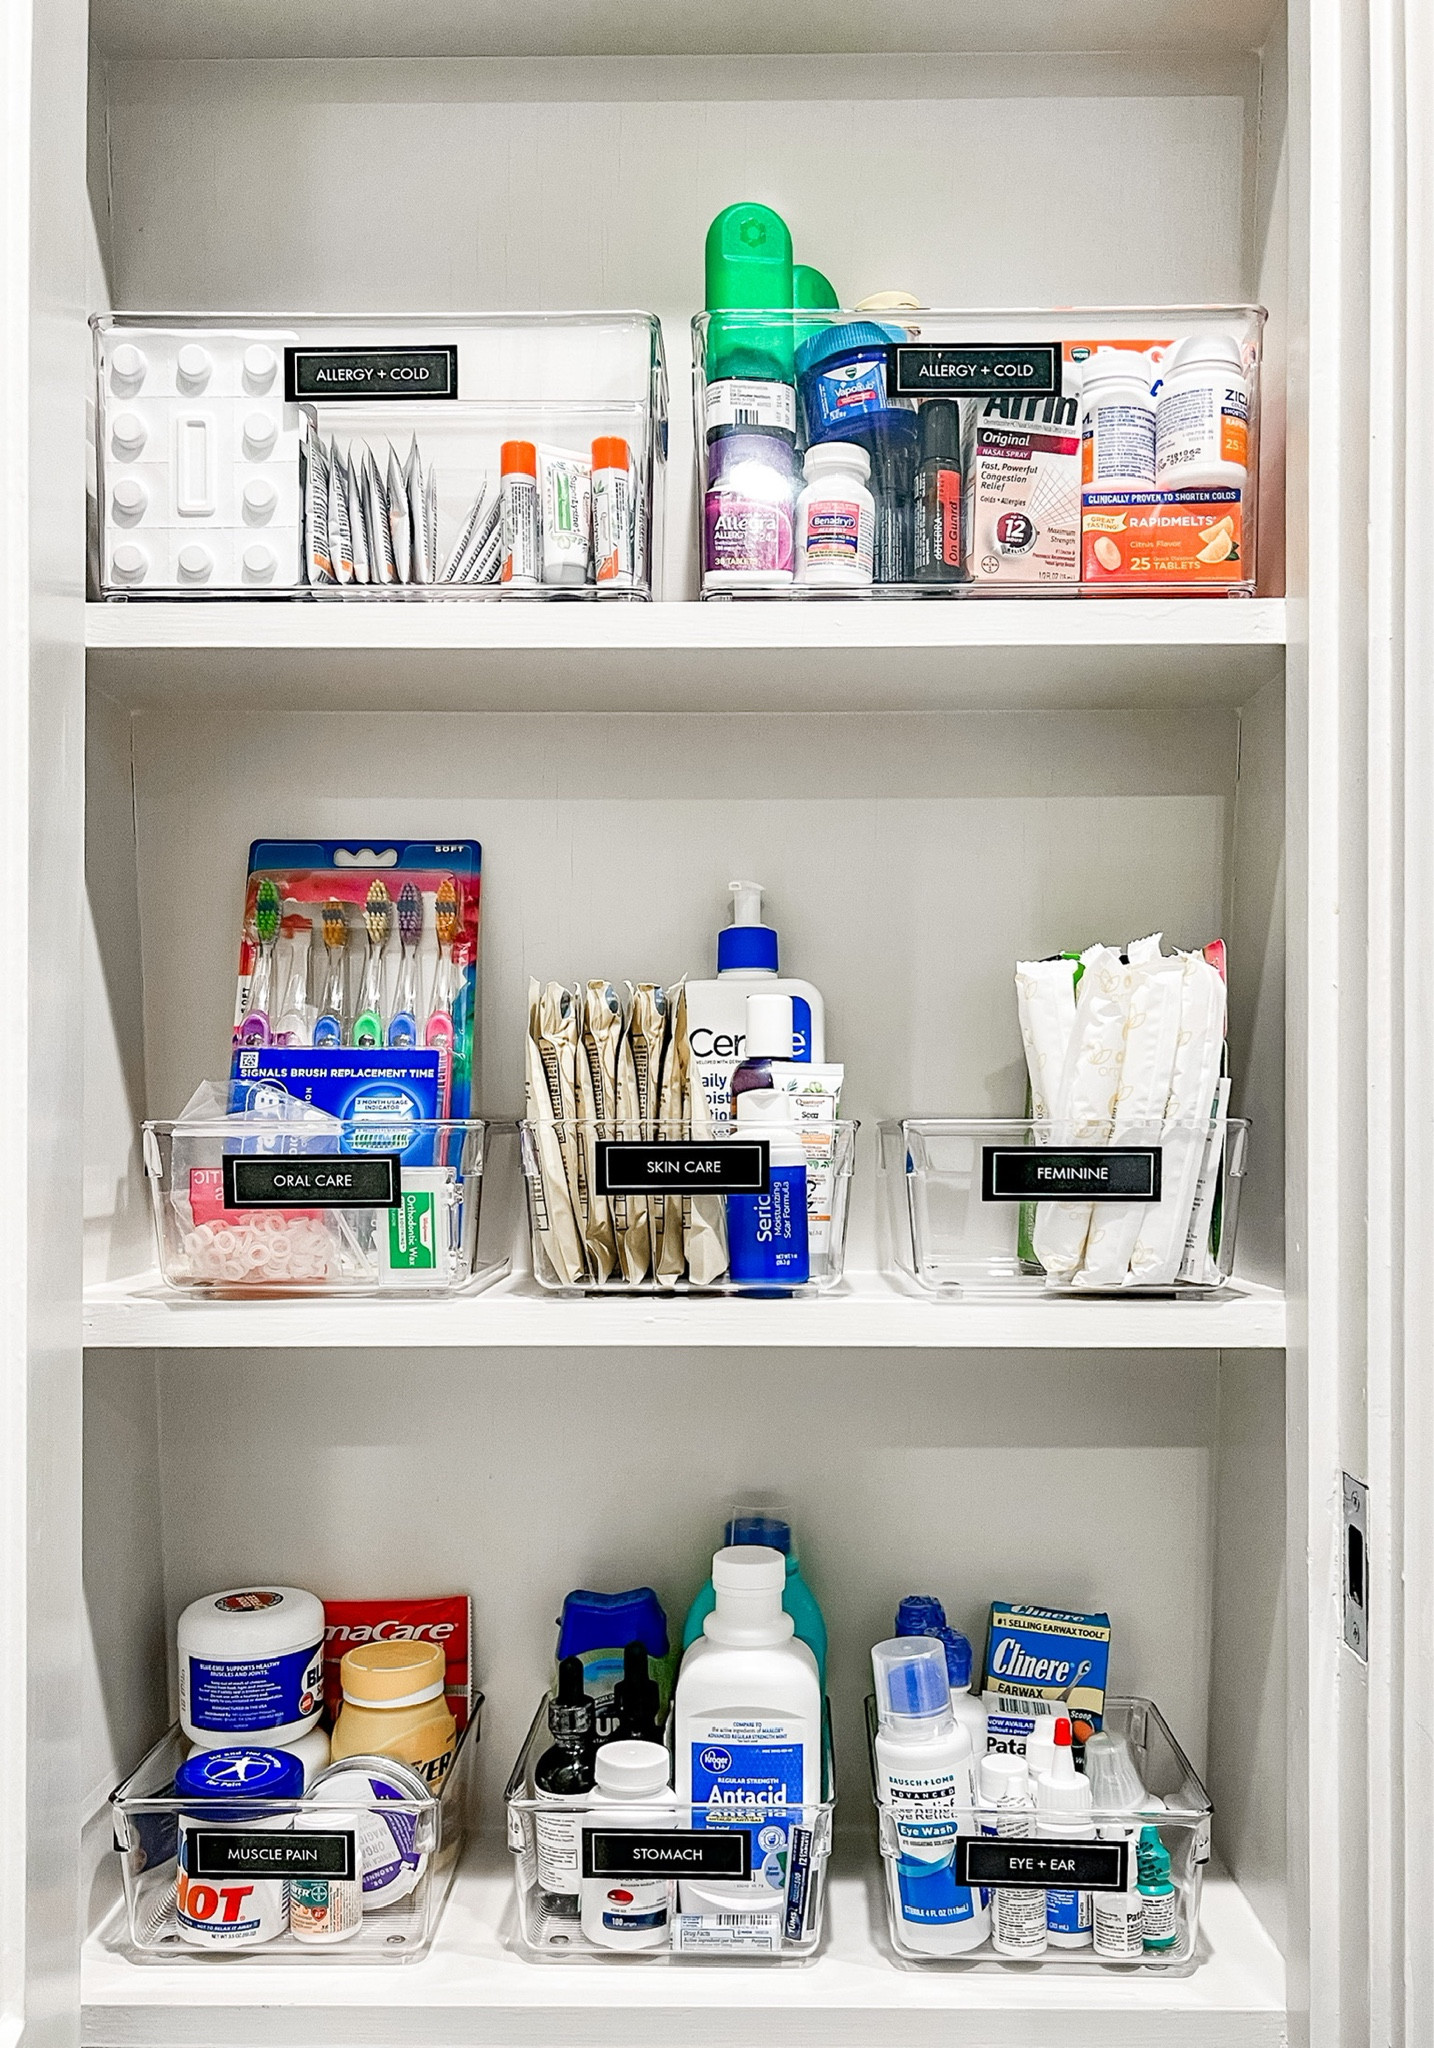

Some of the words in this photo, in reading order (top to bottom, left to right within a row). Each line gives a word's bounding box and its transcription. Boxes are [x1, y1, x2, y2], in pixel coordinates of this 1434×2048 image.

[316, 368, 374, 382] ALLERGY
[376, 371, 387, 379] +
[390, 367, 430, 380] COLD
[918, 364, 977, 378] ALLERGY
[980, 366, 990, 375] +
[994, 364, 1034, 377] COLD
[982, 431, 1030, 446] Original
[982, 448, 1005, 456] NASAL
[1006, 450, 1028, 458] SPRAY
[1002, 462, 1038, 476] Powerful
[980, 471, 1027, 483] Congestion
[980, 482, 1005, 492] Relief
[1088, 494, 1129, 504] CLINICALLY
[1131, 492, 1163, 504] PROVEN
[1163, 493, 1174, 502] TO
[1175, 492, 1210, 501] SHORTEN
[1212, 491, 1236, 500] COLDS
[714, 514, 776, 532] Allegra
[949, 500, 958, 541] Guard
[1129, 516, 1214, 528] RAPIDMELTS
[1005, 519, 1026, 538] 12
[1156, 540, 1182, 548] Flavor
[948, 544, 958, 562] On
[1130, 557, 1151, 571] 25
[1154, 561, 1201, 570] TABLETS
[689, 1028, 806, 1057] Cere
[240, 1068, 288, 1078] SIGNALS
[290, 1068, 328, 1078] BRUSH
[330, 1068, 407, 1078] REPLACEMENT
[409, 1068, 435, 1078] TIME
[702, 1073, 727, 1090] aily
[646, 1161, 680, 1173] SKIN
[684, 1161, 722, 1173] CARE
[1037, 1167, 1109, 1180] FEMININE
[273, 1174, 312, 1187] ORAL
[314, 1174, 352, 1187] CARE
[782, 1181, 791, 1218] Formula
[772, 1182, 782, 1236] Moisturizing
[406, 1195, 416, 1246] Orthodontic
[784, 1220, 792, 1238] Scar
[409, 1246, 418, 1266] Wax
[1010, 1604, 1085, 1622] Clinere
[324, 1620, 454, 1641] maCare
[1008, 1619, 1041, 1630] SELLING
[1043, 1624, 1077, 1636] EARWAX
[226, 1664, 256, 1672] SUPPORTS
[256, 1661, 281, 1670] HEALTHY
[992, 1638, 1070, 1683] Clinere
[998, 1683, 1044, 1699] EARWAX
[1070, 1710, 1092, 1720] Scoop
[986, 1736, 1026, 1756] Pata
[704, 1750, 728, 1770] Kroger
[889, 1776, 922, 1787] BAUSCH
[931, 1774, 954, 1786] LOMB
[708, 1783, 787, 1805] Antacid
[892, 1788, 954, 1799] ADVANCED
[900, 1825, 919, 1836] Eye
[921, 1824, 953, 1836] Wash
[227, 1849, 282, 1860] MUSCLE
[285, 1850, 318, 1861] PAIN
[632, 1848, 703, 1861] STOMACH
[798, 1857, 808, 1866] 12
[1009, 1857, 1034, 1870] EYE
[1037, 1860, 1047, 1868] +
[1050, 1859, 1076, 1871] EAR
[612, 1918, 624, 1926] 100
[788, 1910, 797, 1934] TUMS
